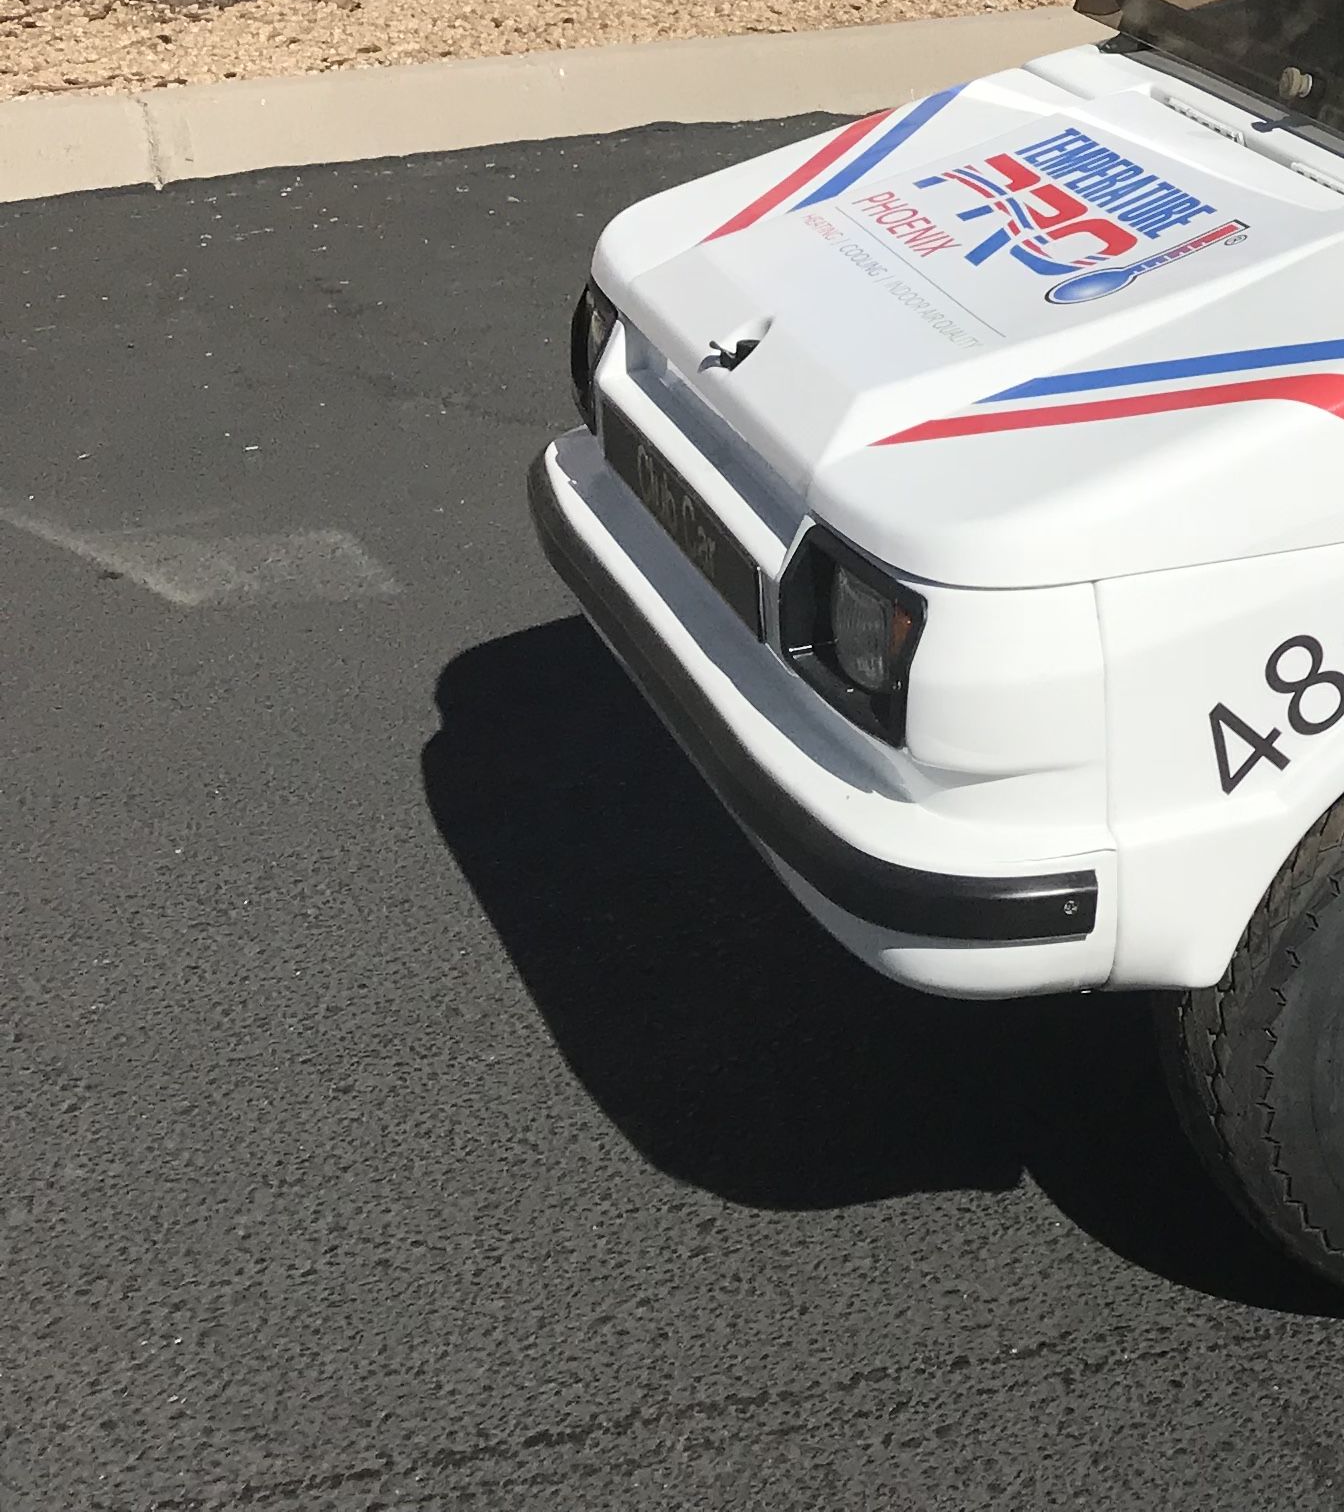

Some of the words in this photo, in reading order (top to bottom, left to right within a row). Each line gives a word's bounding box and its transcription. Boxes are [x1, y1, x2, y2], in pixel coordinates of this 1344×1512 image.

[1014, 127, 1218, 240] TEMPERATURE
[802, 214, 844, 241] HEATING
[852, 191, 962, 258] PHOENIX
[913, 153, 1138, 276] PRO
[839, 244, 888, 277] COOLING
[884, 280, 929, 311] INDOOR
[920, 308, 946, 325] AIR
[932, 319, 985, 348] QUALITY
